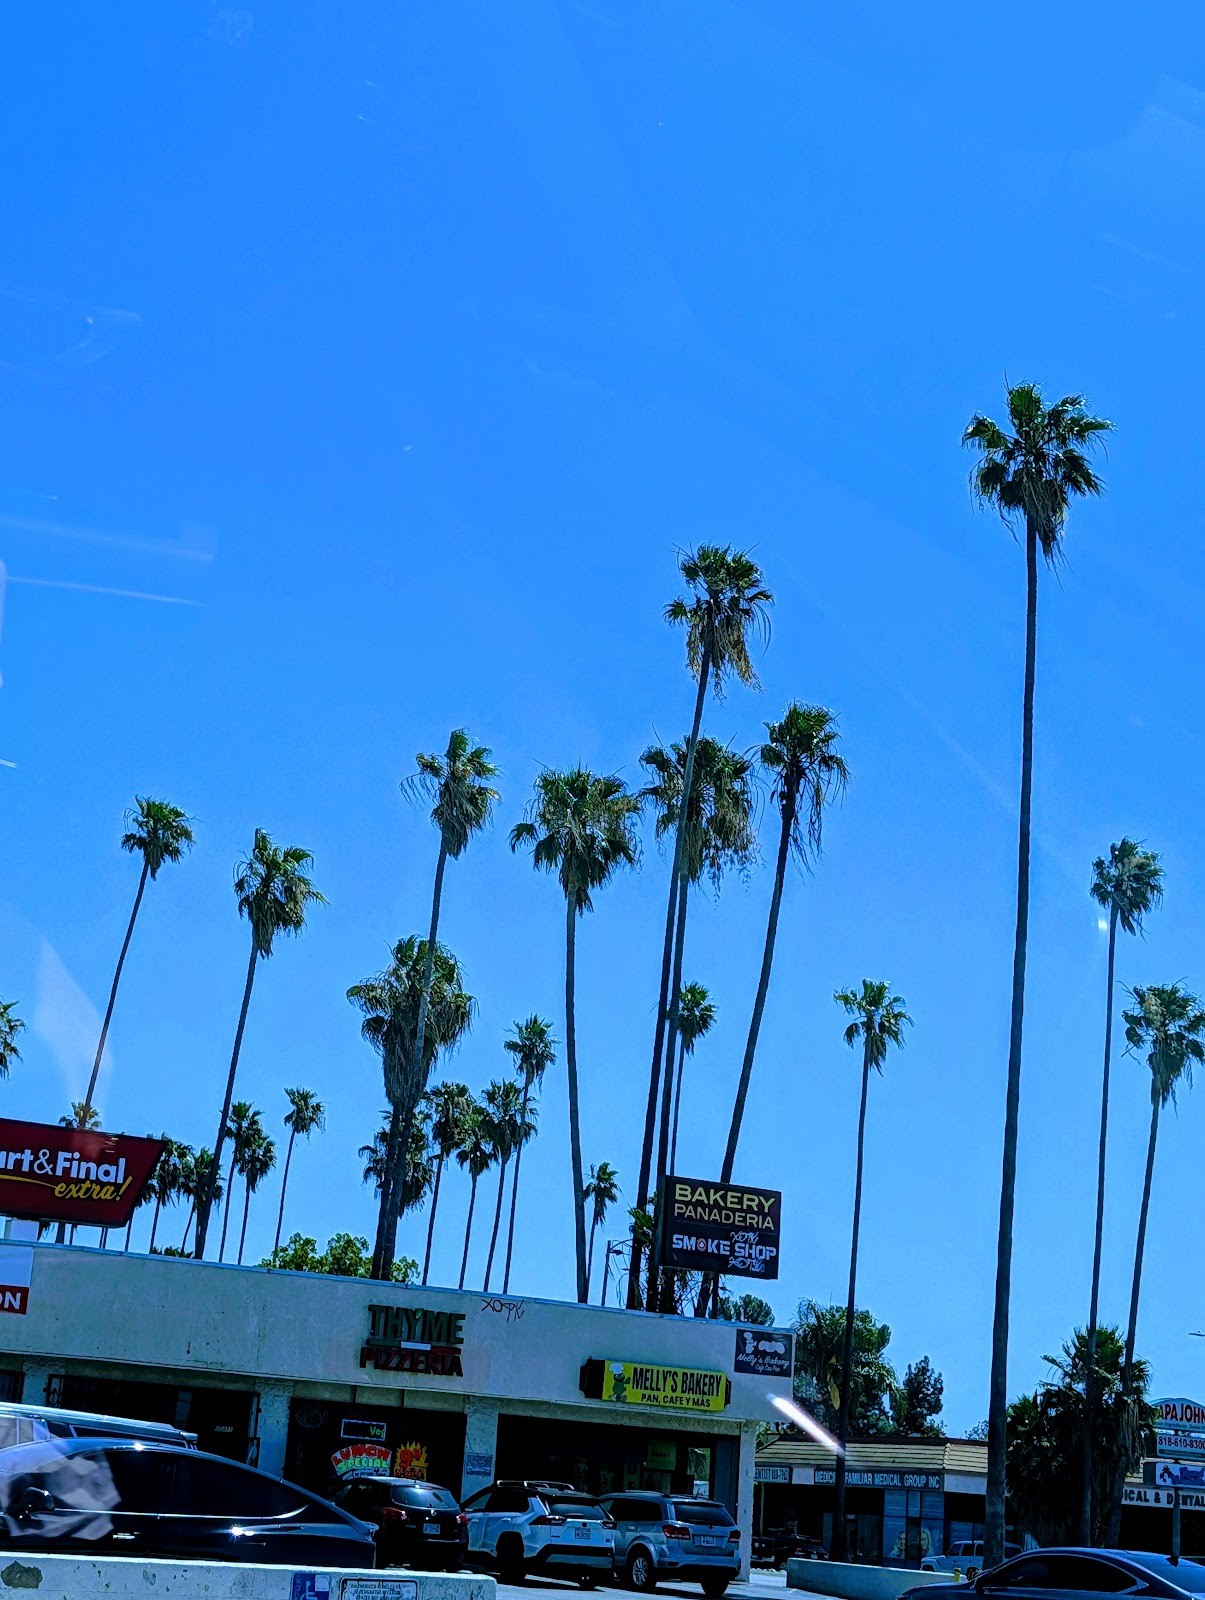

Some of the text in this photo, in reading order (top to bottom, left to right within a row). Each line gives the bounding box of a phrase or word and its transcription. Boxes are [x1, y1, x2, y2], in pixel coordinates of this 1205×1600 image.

[55, 1176, 133, 1201] extra!
[675, 1183, 776, 1213] BAKERY
[674, 1203, 775, 1231] PANADERIA
[734, 1242, 777, 1260] SHOP
[368, 1304, 466, 1344] THYME
[359, 1347, 464, 1377] PIZZERIA
[632, 1366, 722, 1397] MELLY'S BAKERY
[685, 1397, 691, 1406] Y
[336, 1457, 389, 1474] SPECIAL
[844, 1471, 873, 1485] FAMILIAR
[874, 1473, 902, 1486] MEDICAL
[904, 1474, 927, 1488] GROUP
[928, 1476, 940, 1489] INC
